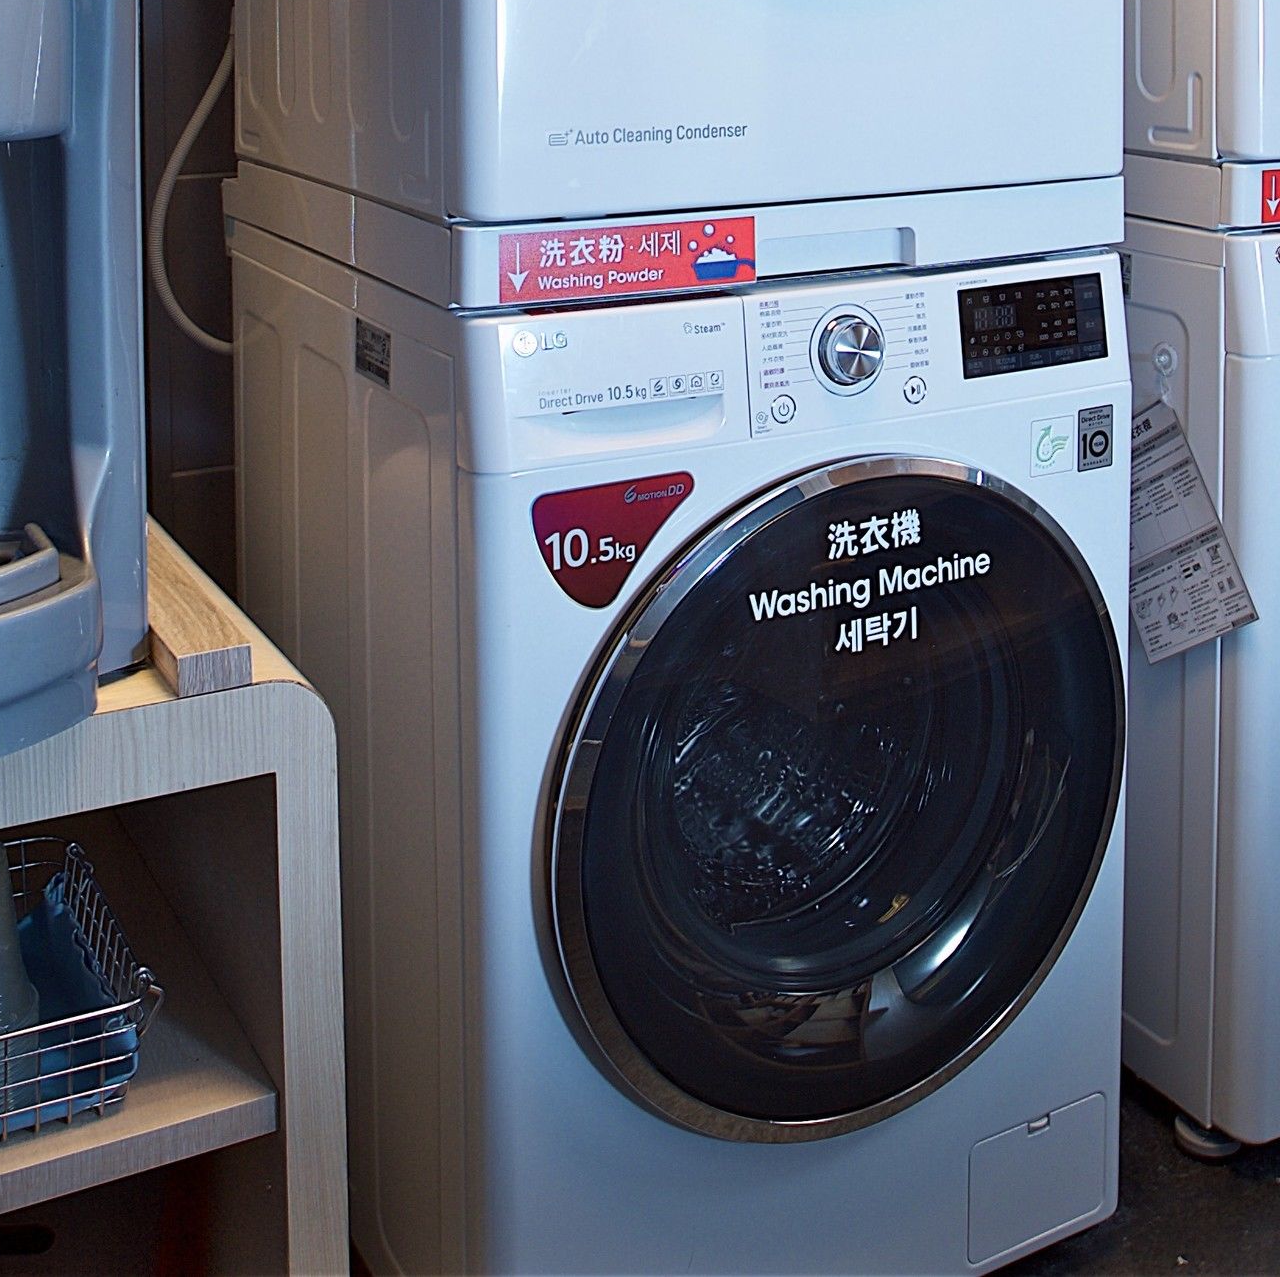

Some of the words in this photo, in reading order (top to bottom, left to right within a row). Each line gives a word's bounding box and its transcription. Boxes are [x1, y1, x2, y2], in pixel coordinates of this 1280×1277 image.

[574, 129, 609, 146] Auto
[612, 126, 672, 144] Cleaning
[676, 123, 748, 141] Condenser
[539, 234, 624, 268] 洗衣粉
[638, 230, 681, 257] 세제
[538, 271, 604, 291] Washing
[608, 267, 663, 285] Powder
[539, 331, 568, 351] LG
[693, 324, 721, 334] Steam
[539, 394, 572, 409] Direct
[575, 391, 603, 405] Drive
[1082, 429, 1109, 460] 10
[637, 491, 666, 502] MOTION
[667, 484, 685, 496] DD
[544, 527, 636, 570] 10.5kg
[828, 508, 921, 561] 洗衣機
[749, 577, 871, 622] Washing
[879, 550, 991, 596] Machine
[835, 606, 919, 653] 세탁기
